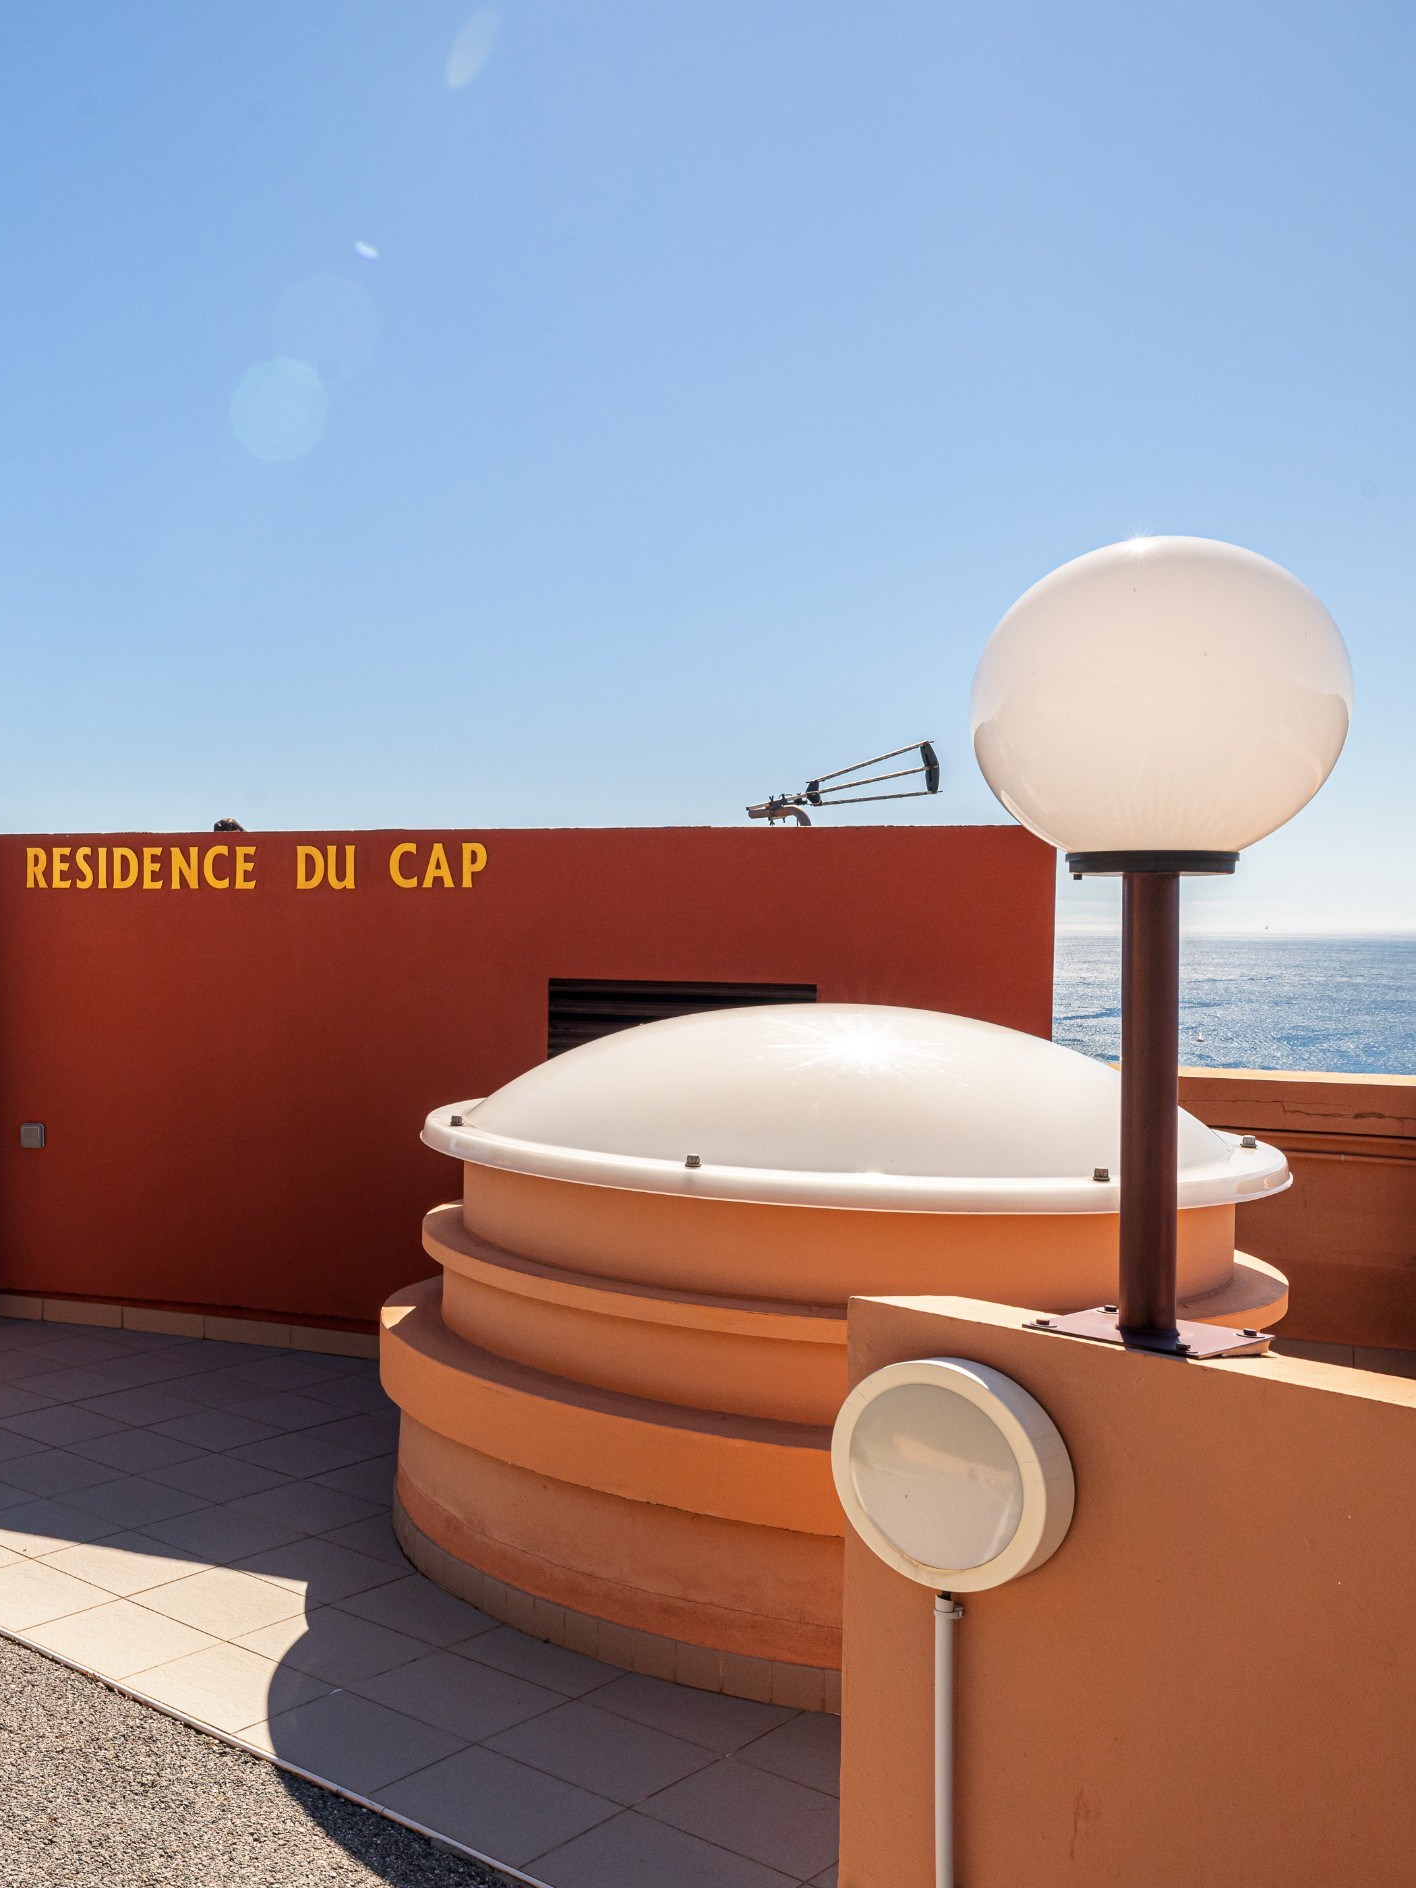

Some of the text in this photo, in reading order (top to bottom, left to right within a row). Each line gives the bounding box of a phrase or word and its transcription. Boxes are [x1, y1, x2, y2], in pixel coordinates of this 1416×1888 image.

[25, 842, 488, 890] RESIDENCE DU CAP
